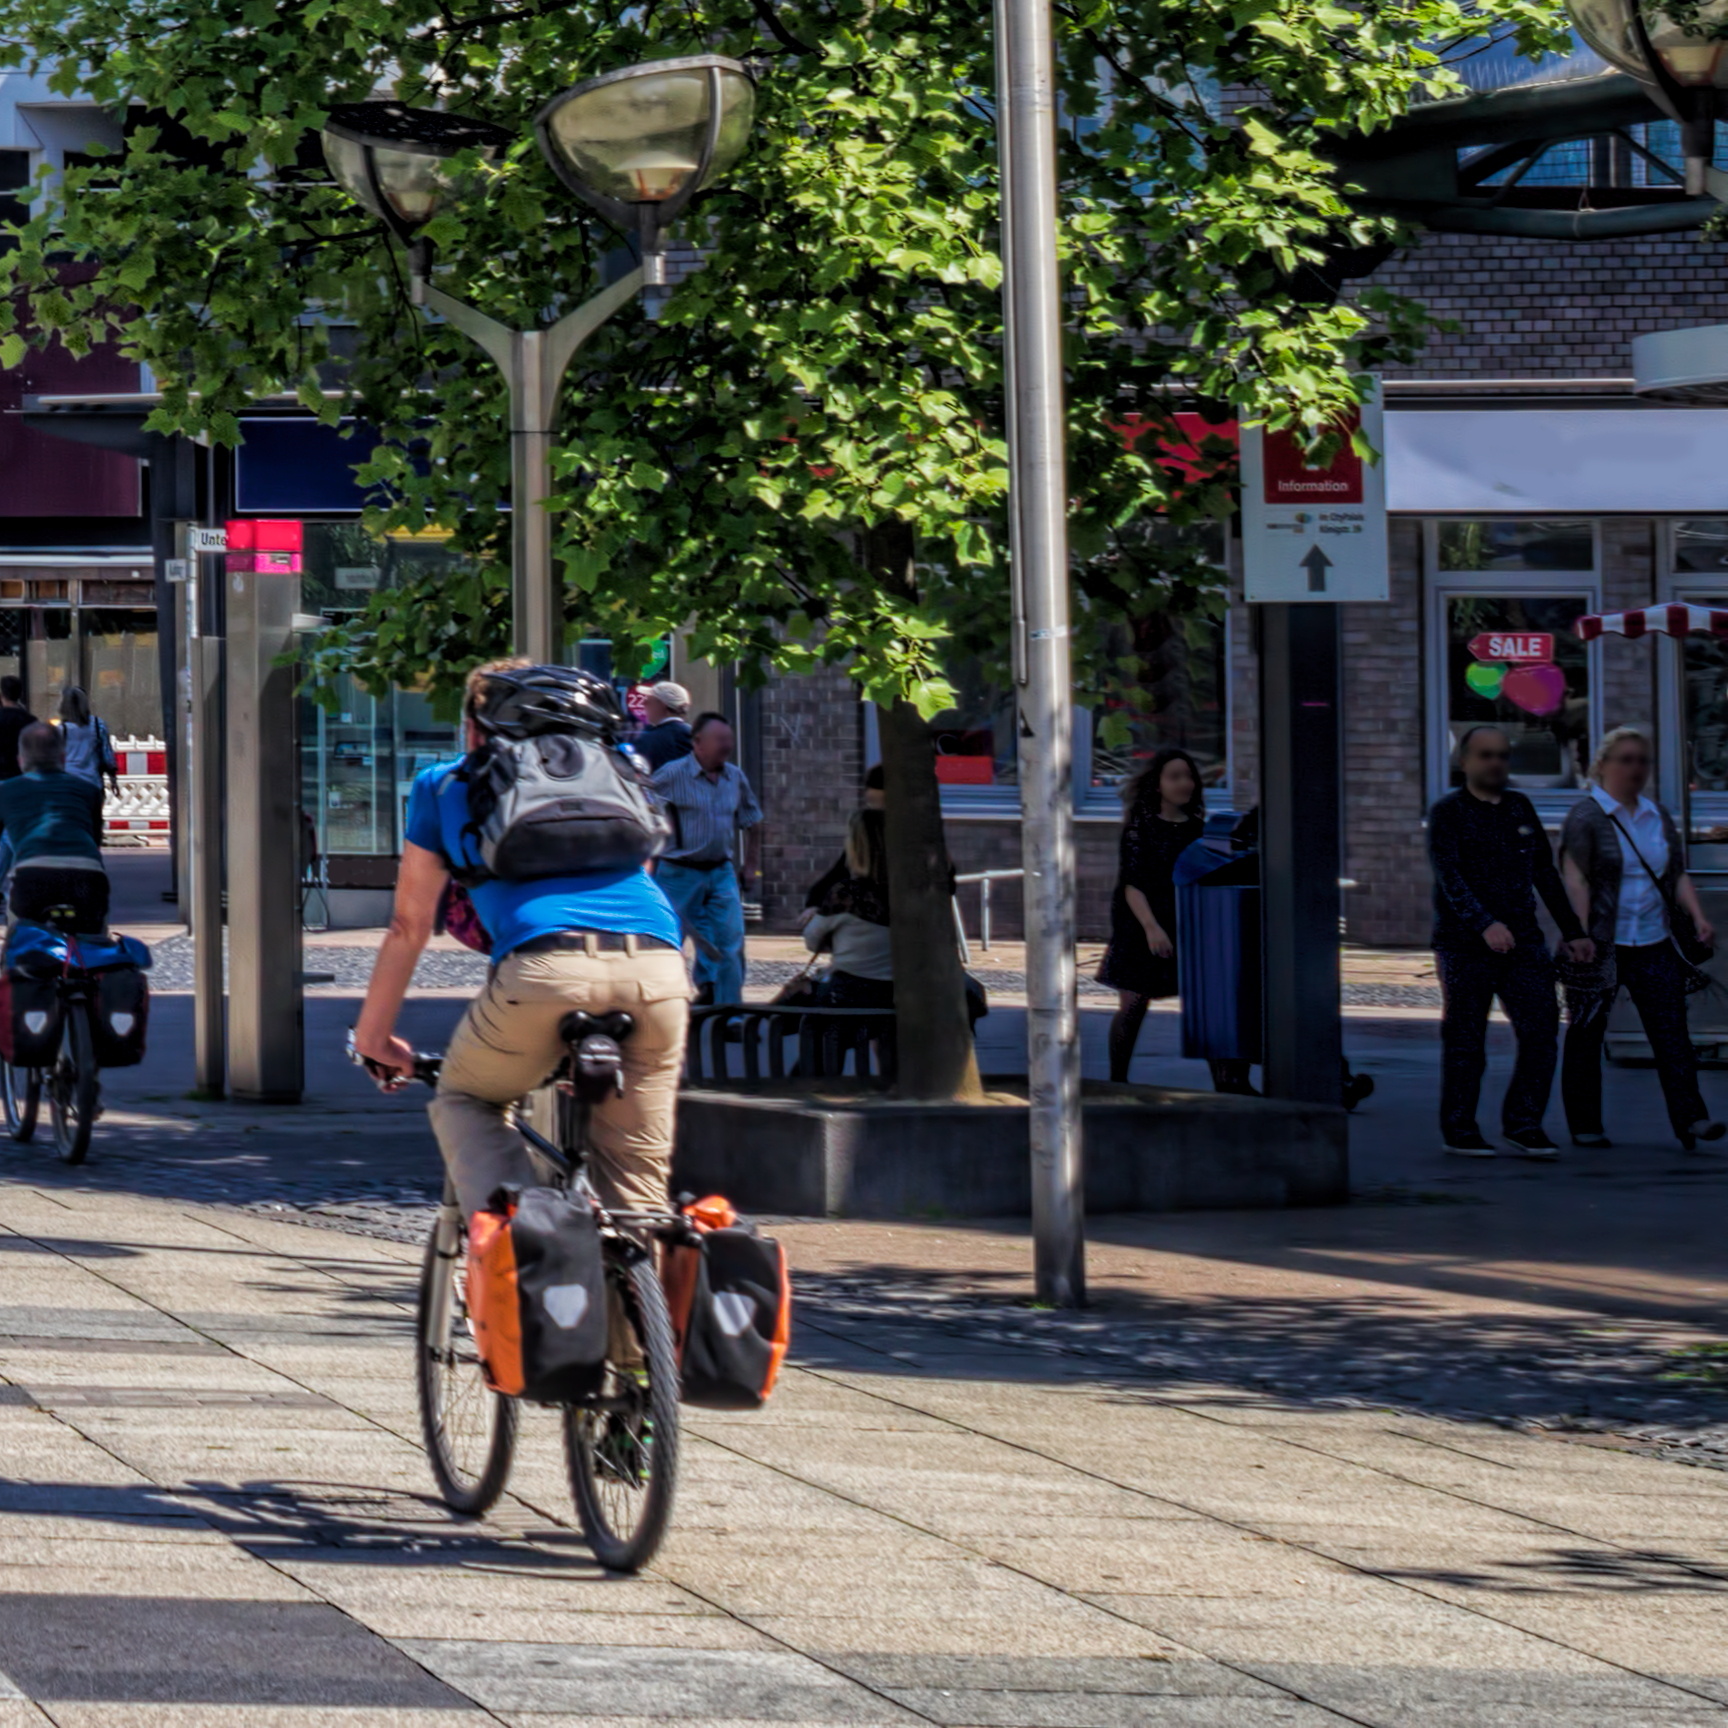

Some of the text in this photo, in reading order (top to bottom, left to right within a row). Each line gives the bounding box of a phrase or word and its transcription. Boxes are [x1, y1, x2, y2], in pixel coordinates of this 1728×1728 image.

[1277, 480, 1348, 491] Information
[201, 532, 227, 545] Unte
[1488, 636, 1542, 656] SALE
